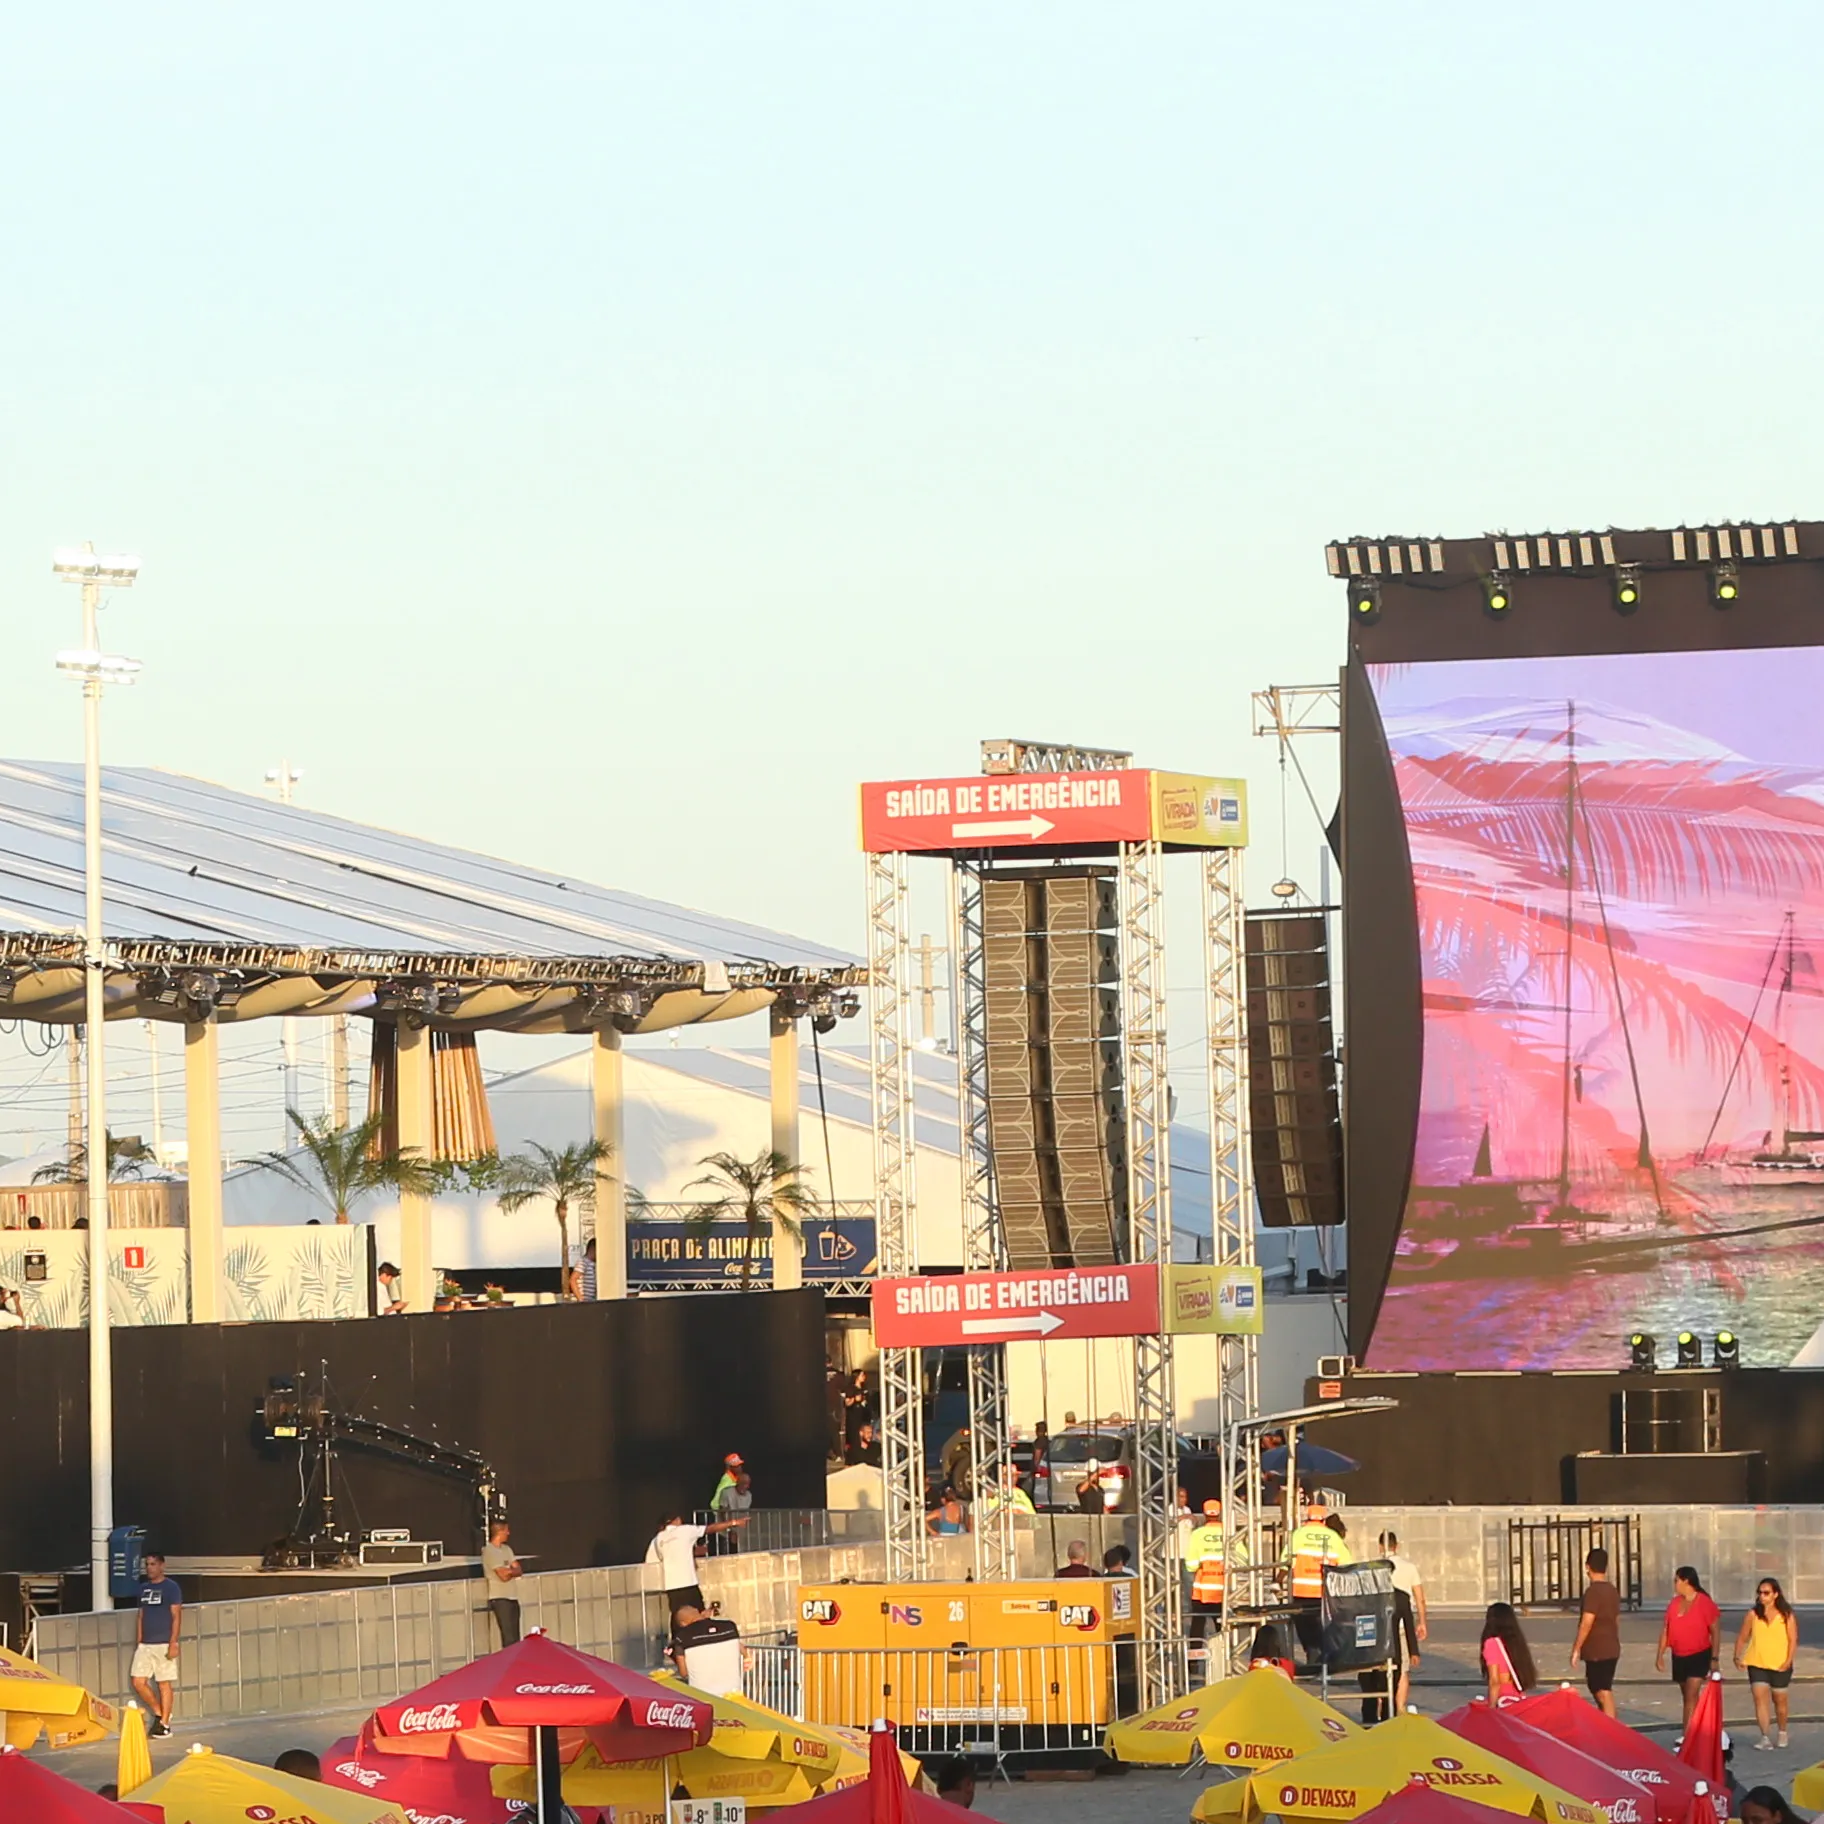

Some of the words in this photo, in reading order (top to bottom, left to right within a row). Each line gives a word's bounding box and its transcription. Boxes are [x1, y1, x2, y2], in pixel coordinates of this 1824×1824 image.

[886, 785, 950, 818] SAÍDA
[956, 786, 983, 813] DE
[988, 775, 1121, 812] EMERGÊNCIA
[632, 1238, 680, 1262] PRAÇA
[685, 1238, 703, 1258] DE
[896, 1279, 959, 1314] SAÍDA
[966, 1283, 991, 1309] DE
[997, 1272, 1129, 1307] EMERGÊNCIA
[802, 1601, 833, 1621] CAT
[948, 1601, 964, 1622] 26
[1060, 1606, 1091, 1627] CAT
[398, 1704, 457, 1733] Coca-Cola
[646, 1701, 694, 1729] Coca-Cola
[1244, 1743, 1294, 1760] DEVASSA
[1302, 1788, 1357, 1808] DEVASSA
